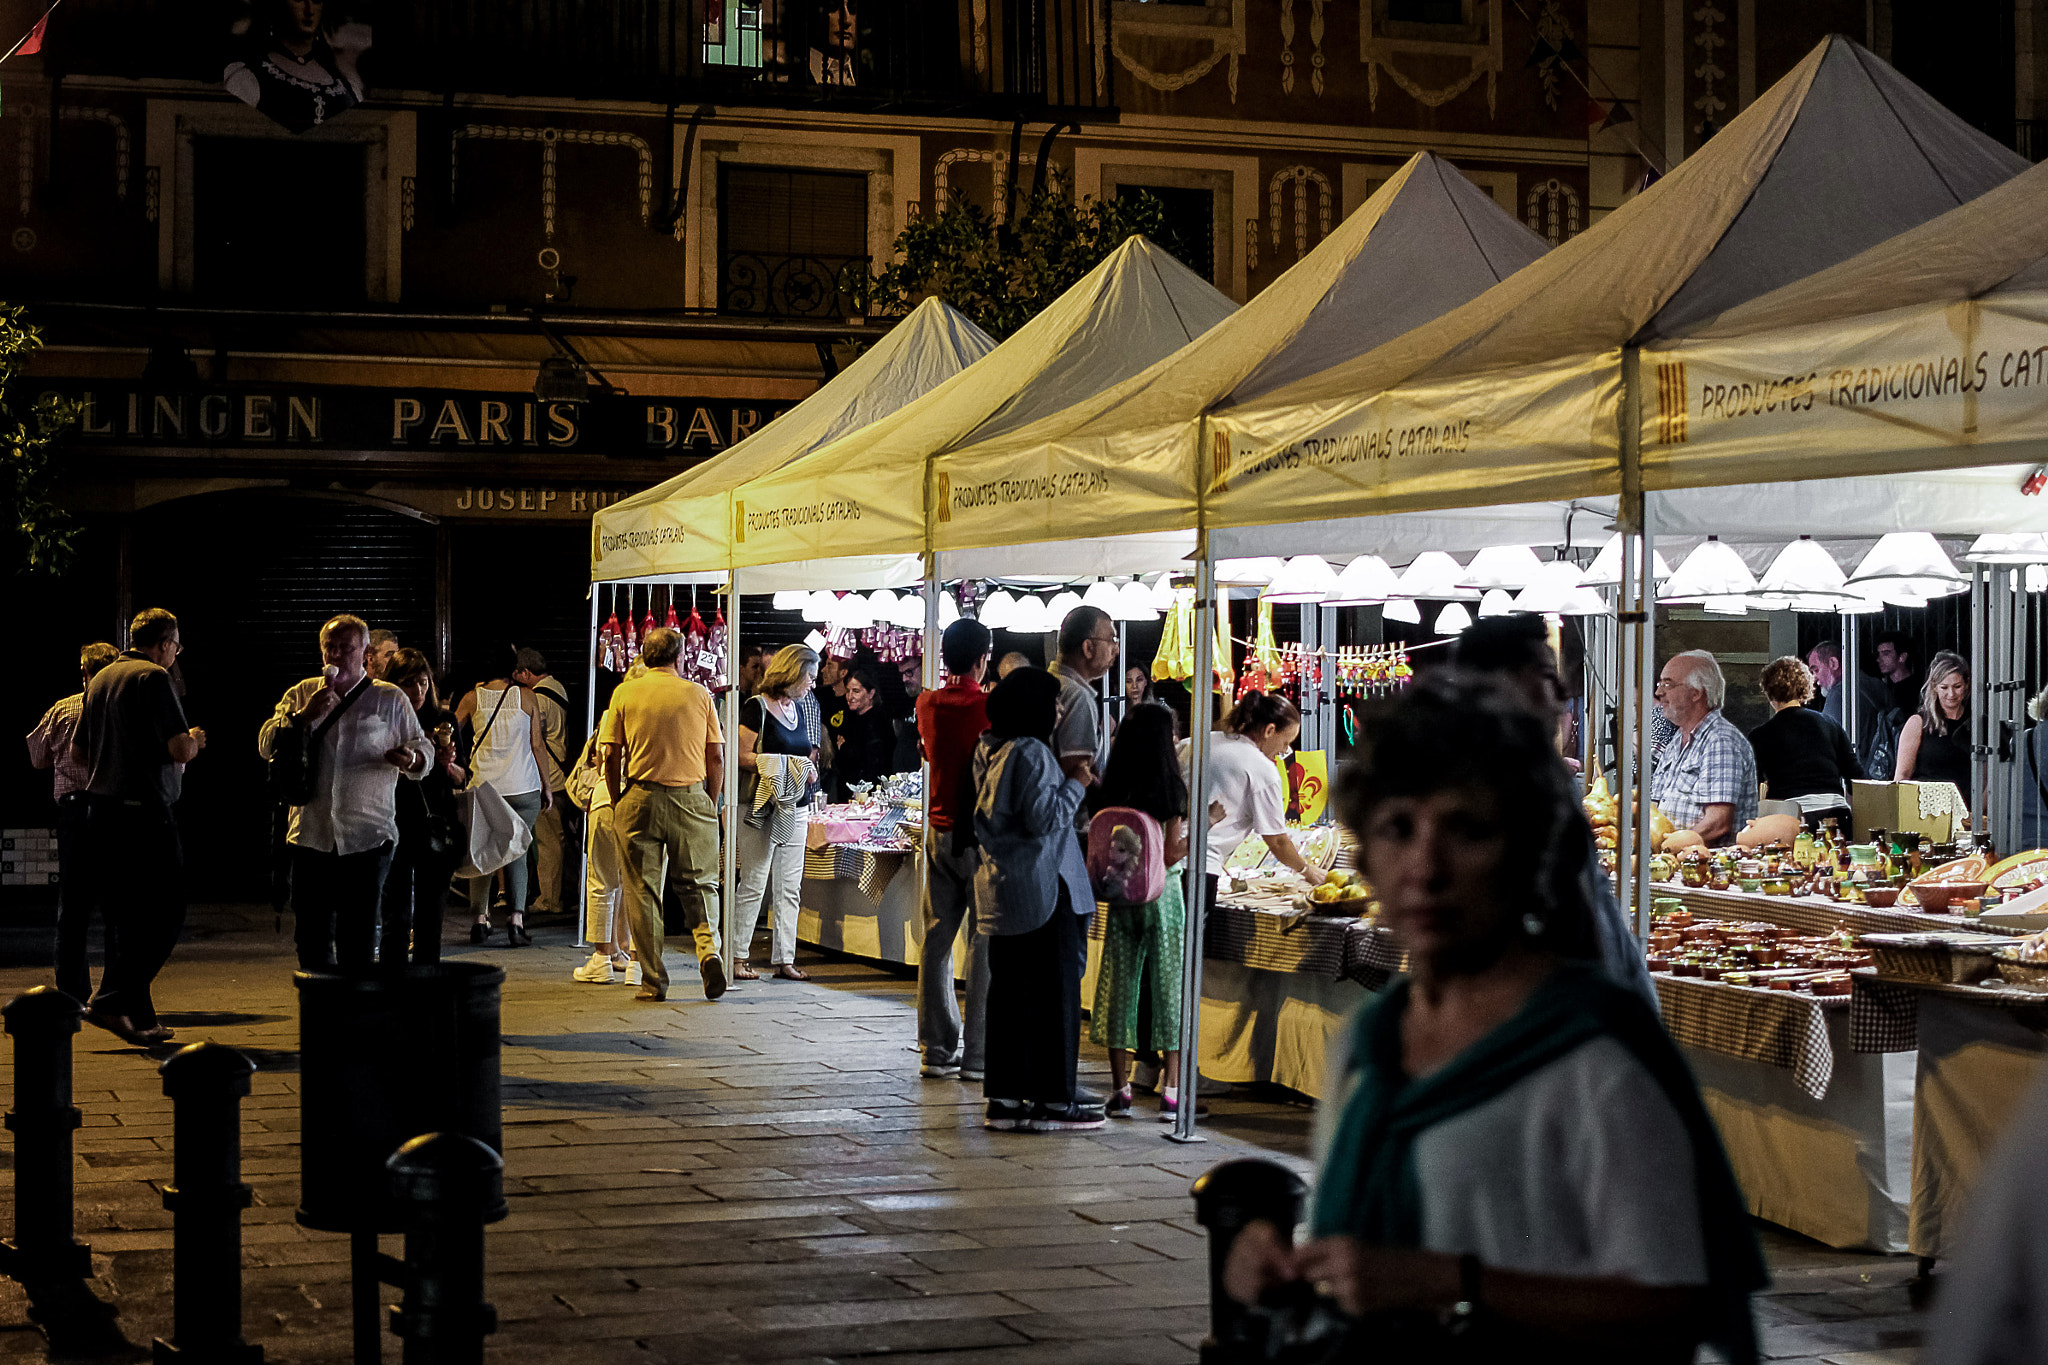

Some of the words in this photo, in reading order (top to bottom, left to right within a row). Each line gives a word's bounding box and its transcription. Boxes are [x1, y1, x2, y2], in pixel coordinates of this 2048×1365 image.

[1701, 374, 1817, 420] PRODUCTES
[1828, 350, 1990, 408] TRADICIONALS
[2000, 345, 2048, 388] CAT
[391, 398, 579, 448] PARIS
[646, 404, 790, 450] BAR
[1303, 428, 1394, 466] TRADICIONALS
[1398, 420, 1471, 456] CATALANS
[456, 486, 558, 512] JOSEP
[953, 481, 997, 509] PRODUCTES
[1000, 473, 1057, 503] TRADICIONALS
[1059, 470, 1109, 496] CATALANS
[747, 508, 780, 532] PRODUCTES
[781, 502, 825, 527] TRADICIONALS
[826, 499, 861, 522] CATALANS
[700, 652, 714, 664] 23
